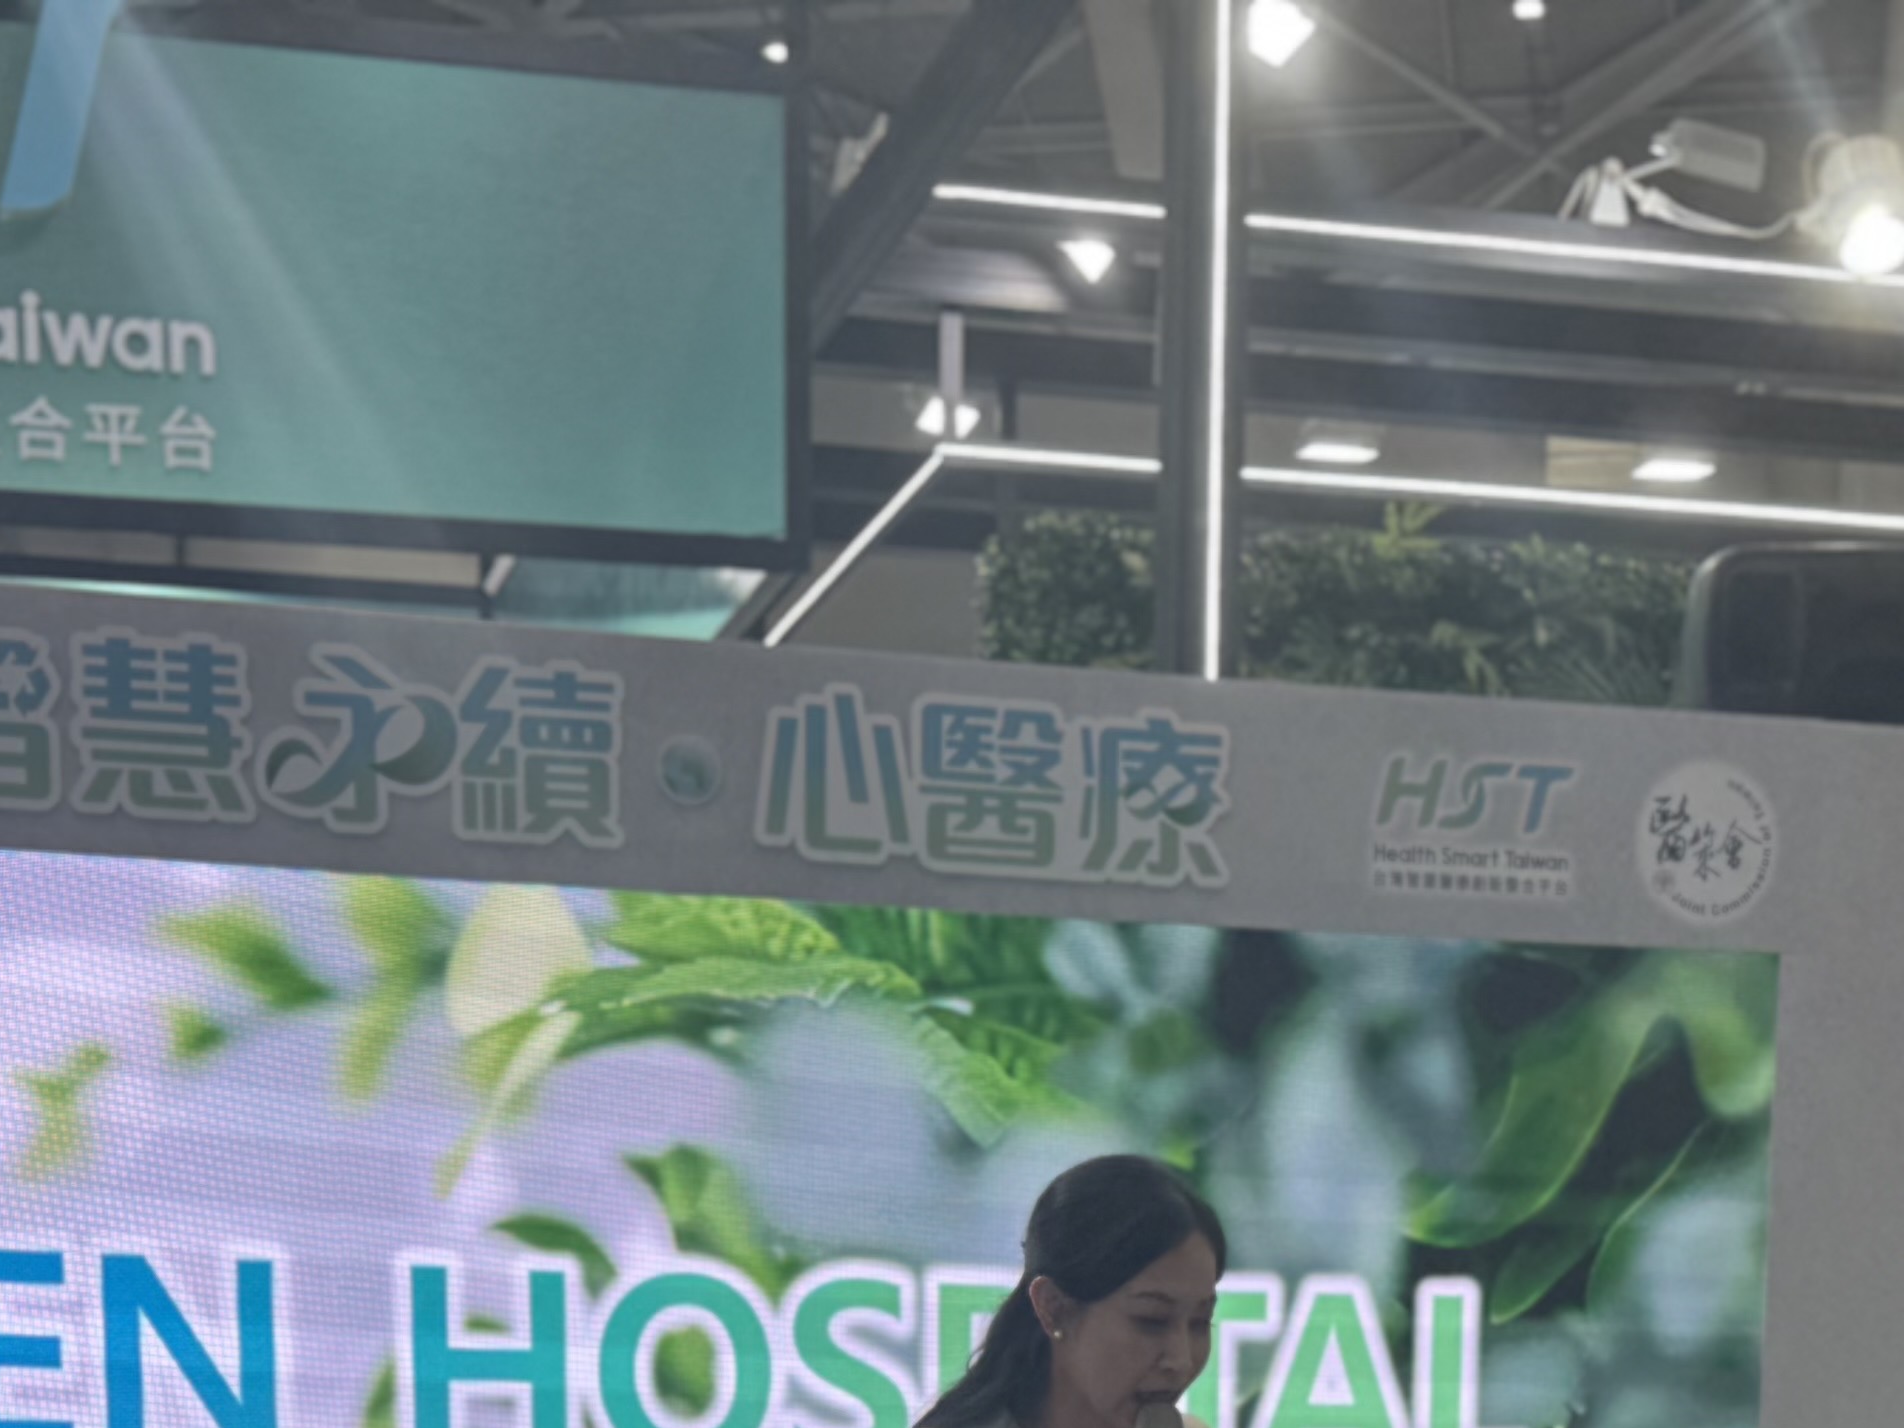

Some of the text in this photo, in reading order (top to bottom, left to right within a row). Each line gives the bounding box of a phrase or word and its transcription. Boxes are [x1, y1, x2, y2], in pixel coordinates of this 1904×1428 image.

[1376, 757, 1574, 834] HST
[1373, 843, 1570, 872] Health Smart Taiwan
